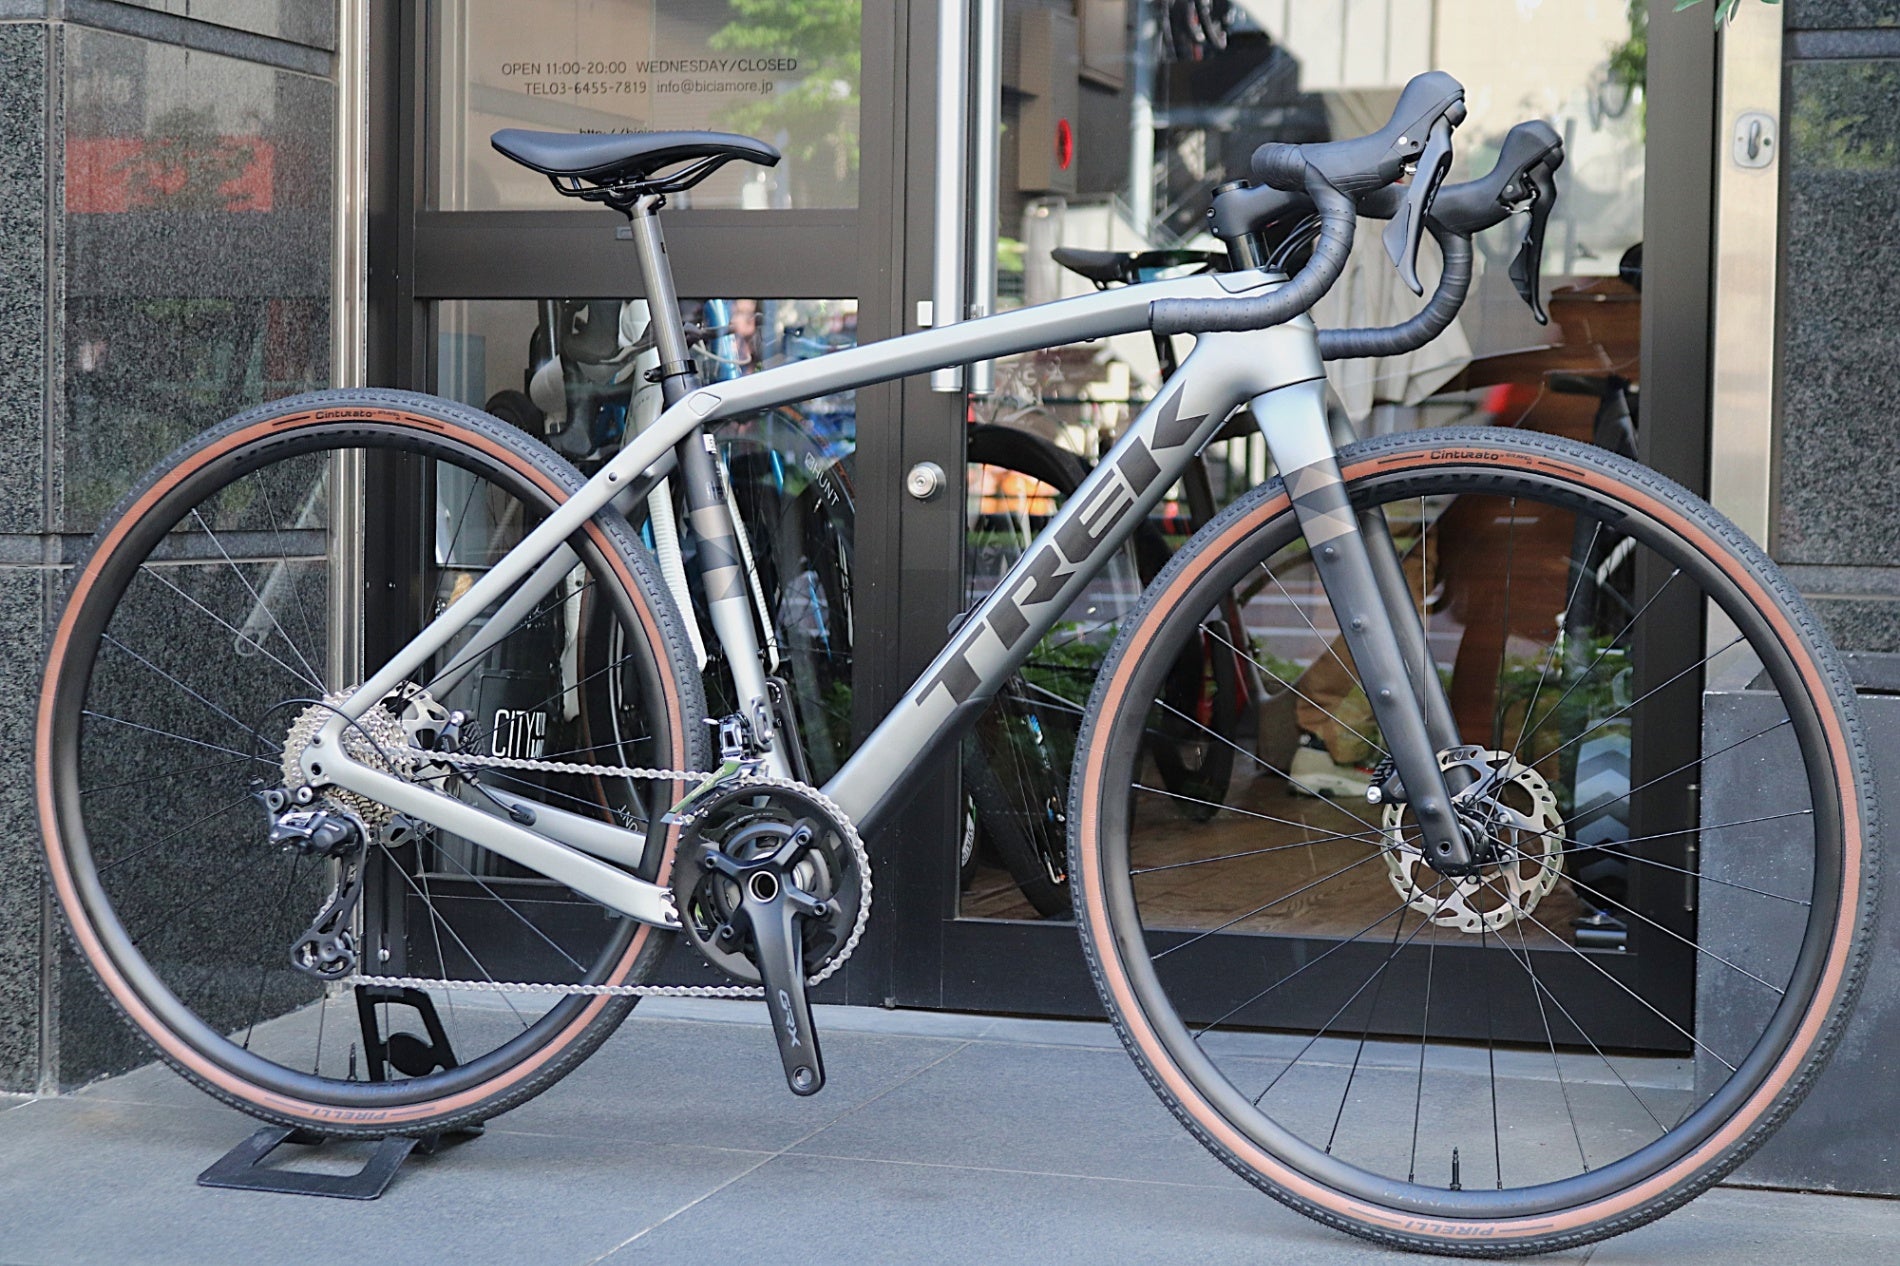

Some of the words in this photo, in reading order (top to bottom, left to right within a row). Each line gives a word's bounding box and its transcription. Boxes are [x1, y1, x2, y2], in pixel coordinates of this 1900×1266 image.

[501, 62, 541, 76] OPEN
[546, 61, 627, 75] 11:00-20:00
[636, 58, 797, 73] WEDNESDAY/CLOSED
[524, 81, 647, 95] TEL03-6455-7819
[656, 79, 773, 94] info@biciamore.jp
[1430, 450, 1499, 461] Cinturato
[811, 462, 840, 506] HUNT
[915, 379, 1210, 706] TREK
[491, 708, 536, 758] CITY
[778, 988, 802, 1048] GRX
[312, 1107, 388, 1121] PIRELLI
[1404, 1220, 1496, 1236] PIRELLI
